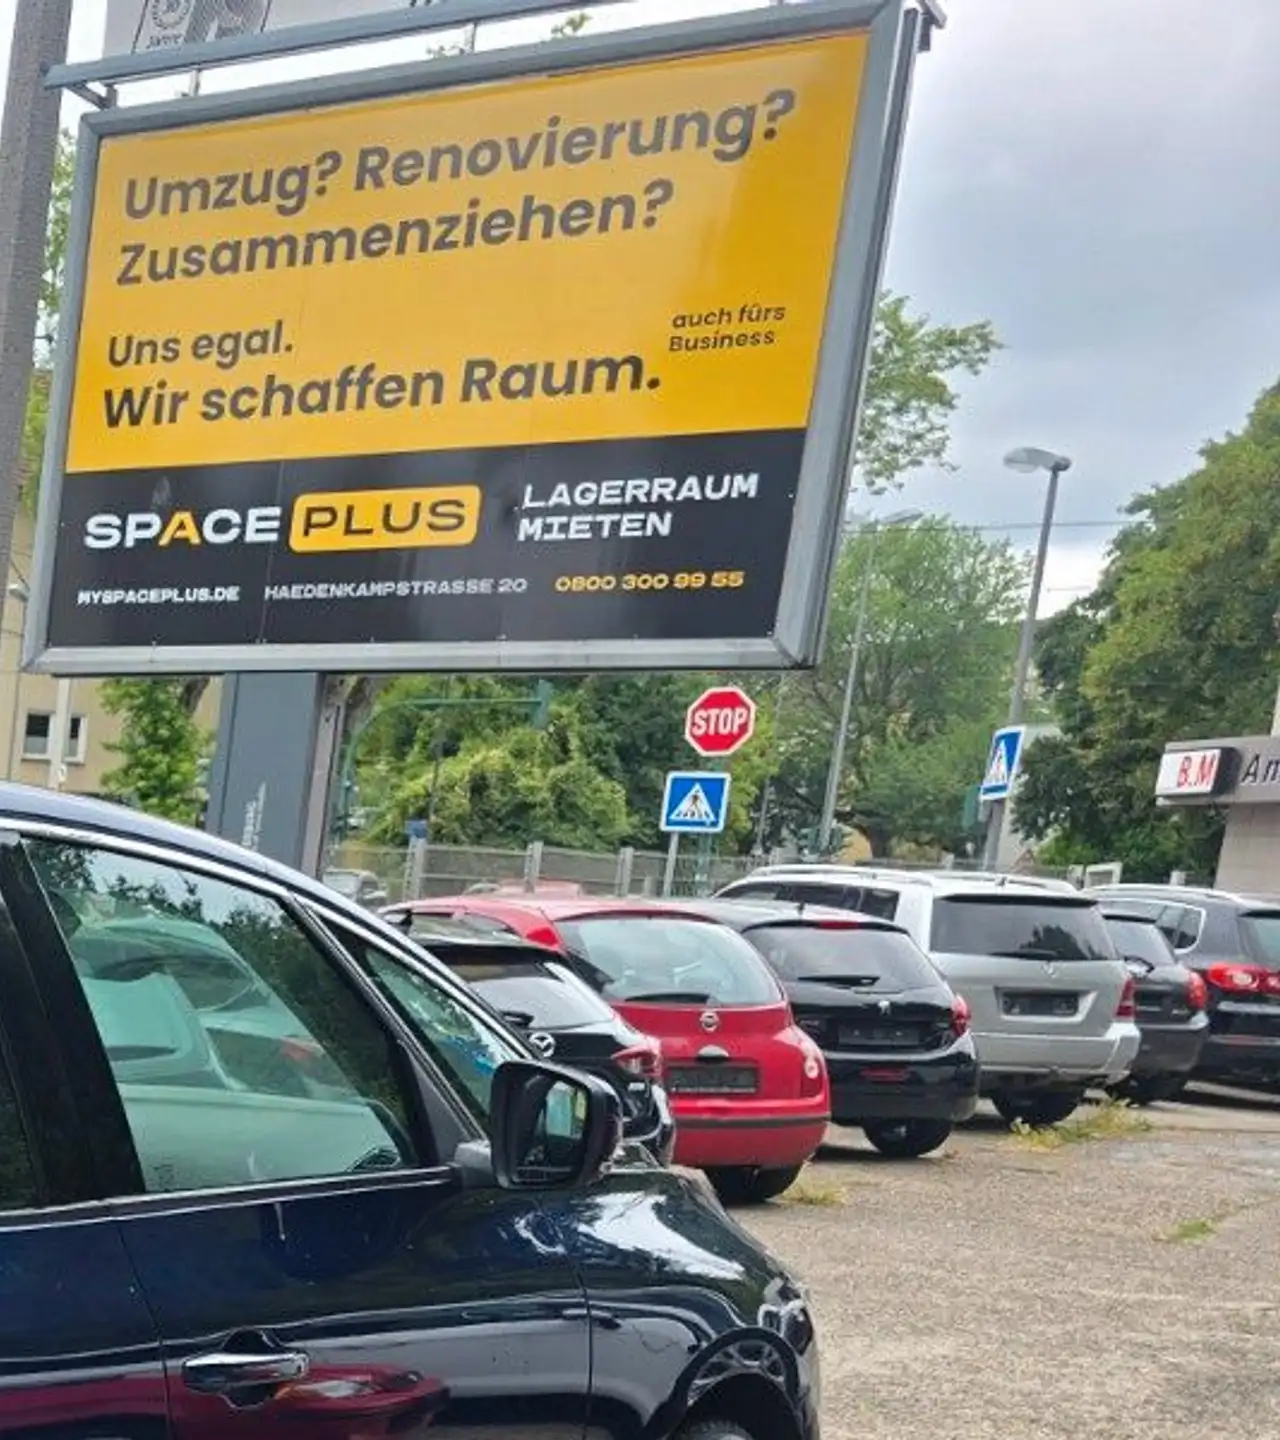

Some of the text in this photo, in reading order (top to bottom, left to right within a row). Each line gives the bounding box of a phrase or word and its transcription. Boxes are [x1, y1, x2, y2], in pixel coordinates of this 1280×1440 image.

[125, 89, 796, 219] Umzug? Renovierung?
[116, 178, 674, 286] Zusammenziehen?
[672, 308, 732, 328] auch
[108, 320, 293, 369] Uns egal.
[669, 331, 775, 351] Business
[104, 355, 660, 428] Wir schaffen Raum.
[522, 473, 759, 509] LAGERRAUM
[84, 499, 466, 549] SPACE PLUS
[518, 511, 672, 541] MIETEN
[77, 586, 240, 604] MYSPACEPLUS.DE
[264, 577, 528, 600] HAEDENKAMPSTRASSE 20
[555, 575, 616, 592] 0800
[622, 573, 669, 590] 300
[691, 707, 749, 737] STOP
